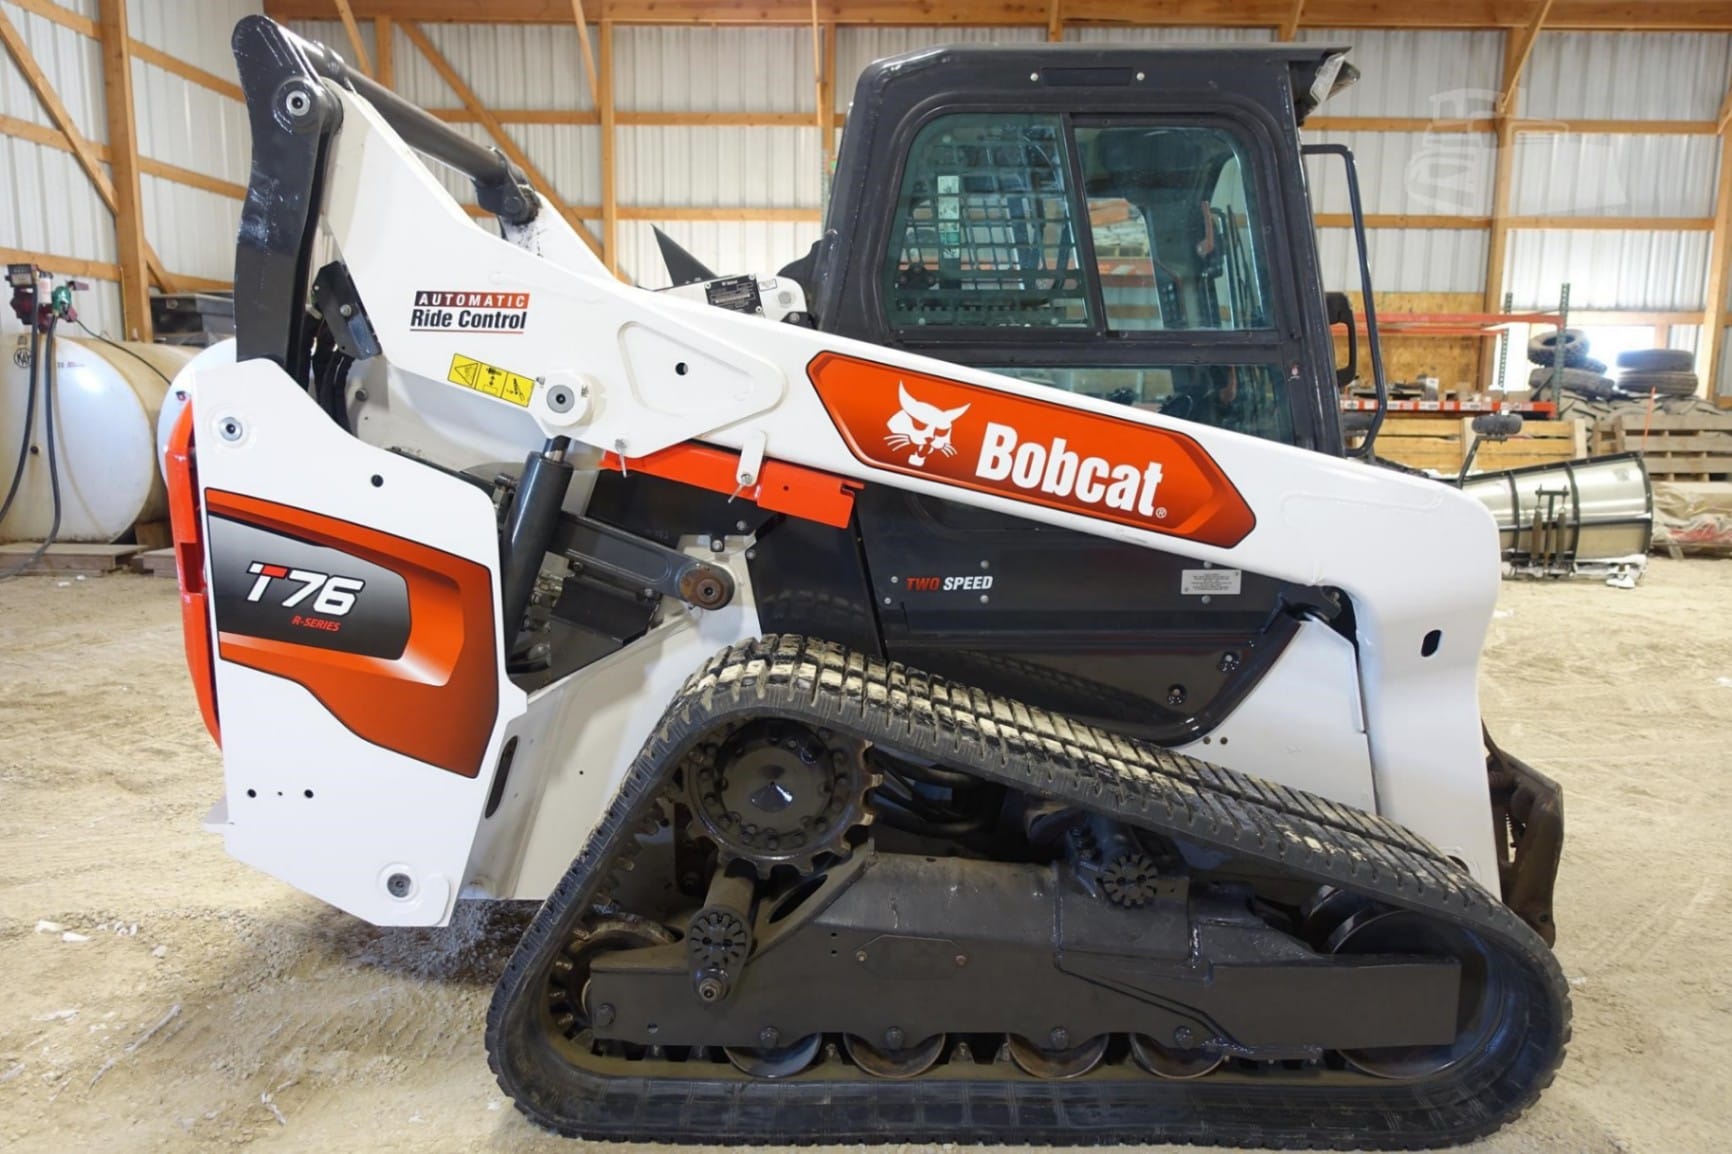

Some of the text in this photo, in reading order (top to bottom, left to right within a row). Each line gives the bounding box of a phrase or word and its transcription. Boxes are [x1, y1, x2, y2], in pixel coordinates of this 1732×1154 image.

[418, 293, 525, 307] AUTOMATIC
[410, 309, 527, 329] Ride Control
[975, 421, 1164, 517] Bobcat
[247, 561, 365, 616] T76
[906, 576, 994, 591] TWO SPEED
[291, 615, 341, 632] R-SERIES
